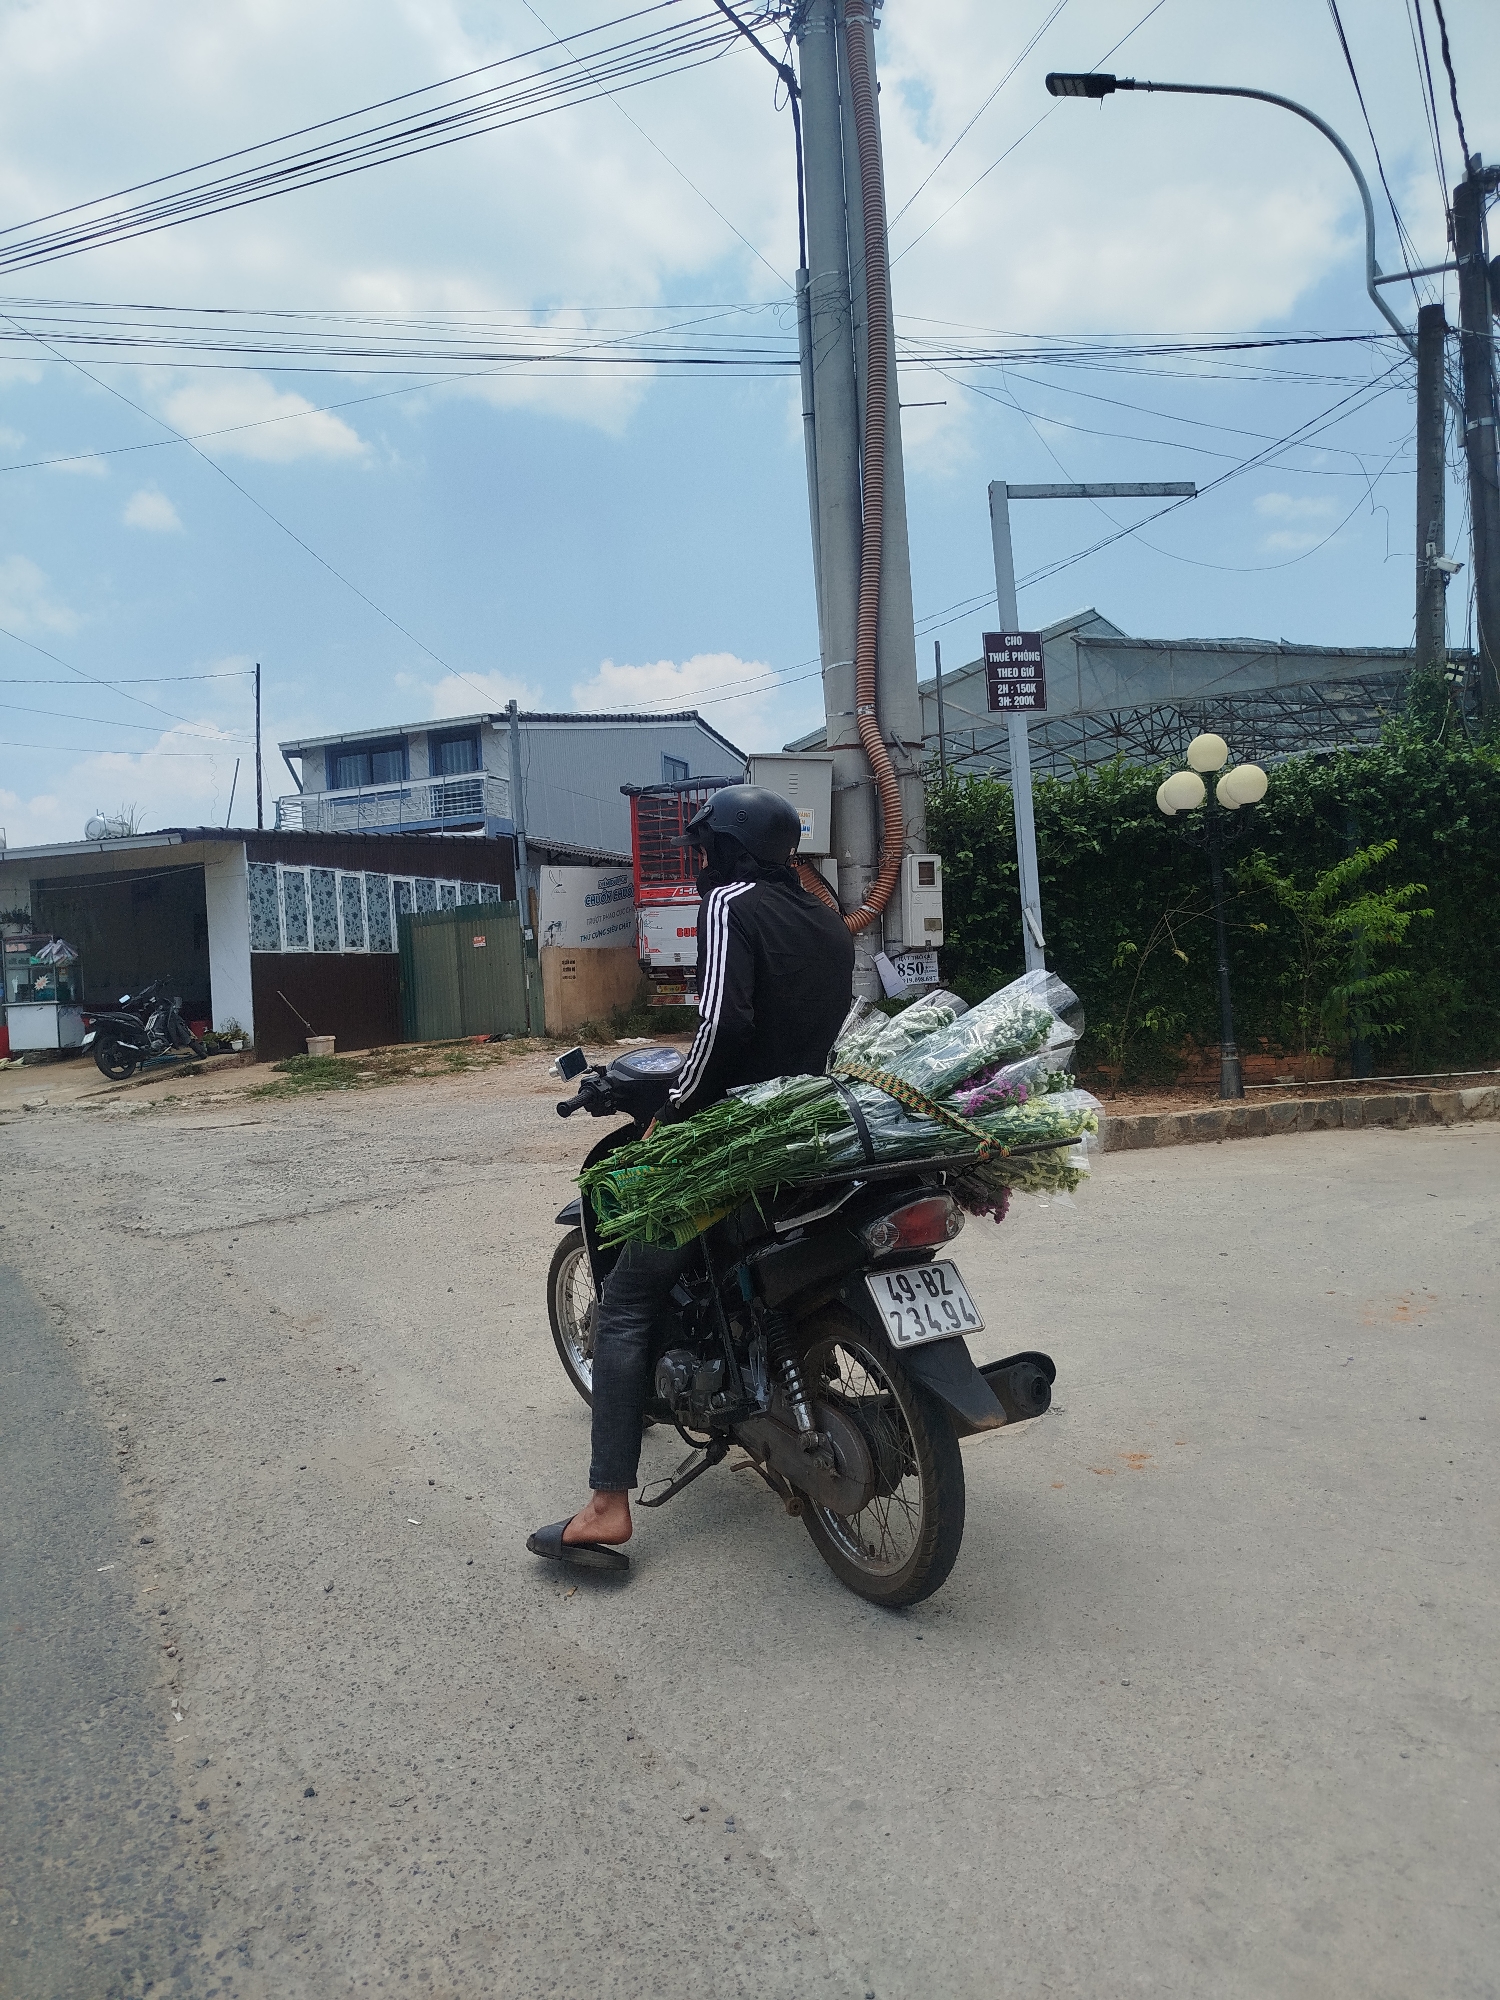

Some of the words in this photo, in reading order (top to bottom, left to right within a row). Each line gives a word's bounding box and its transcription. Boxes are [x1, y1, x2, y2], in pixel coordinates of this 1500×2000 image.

[1004, 635, 1023, 646] CHO
[988, 650, 1011, 662] THUÊ
[997, 667, 1019, 678] THEO
[997, 683, 1009, 695] 2H
[1015, 682, 1037, 694] 150K
[1013, 695, 1035, 706] 200K
[897, 961, 924, 977] 850
[885, 1268, 953, 1304] 49-B2
[890, 1297, 976, 1341] 234.94
